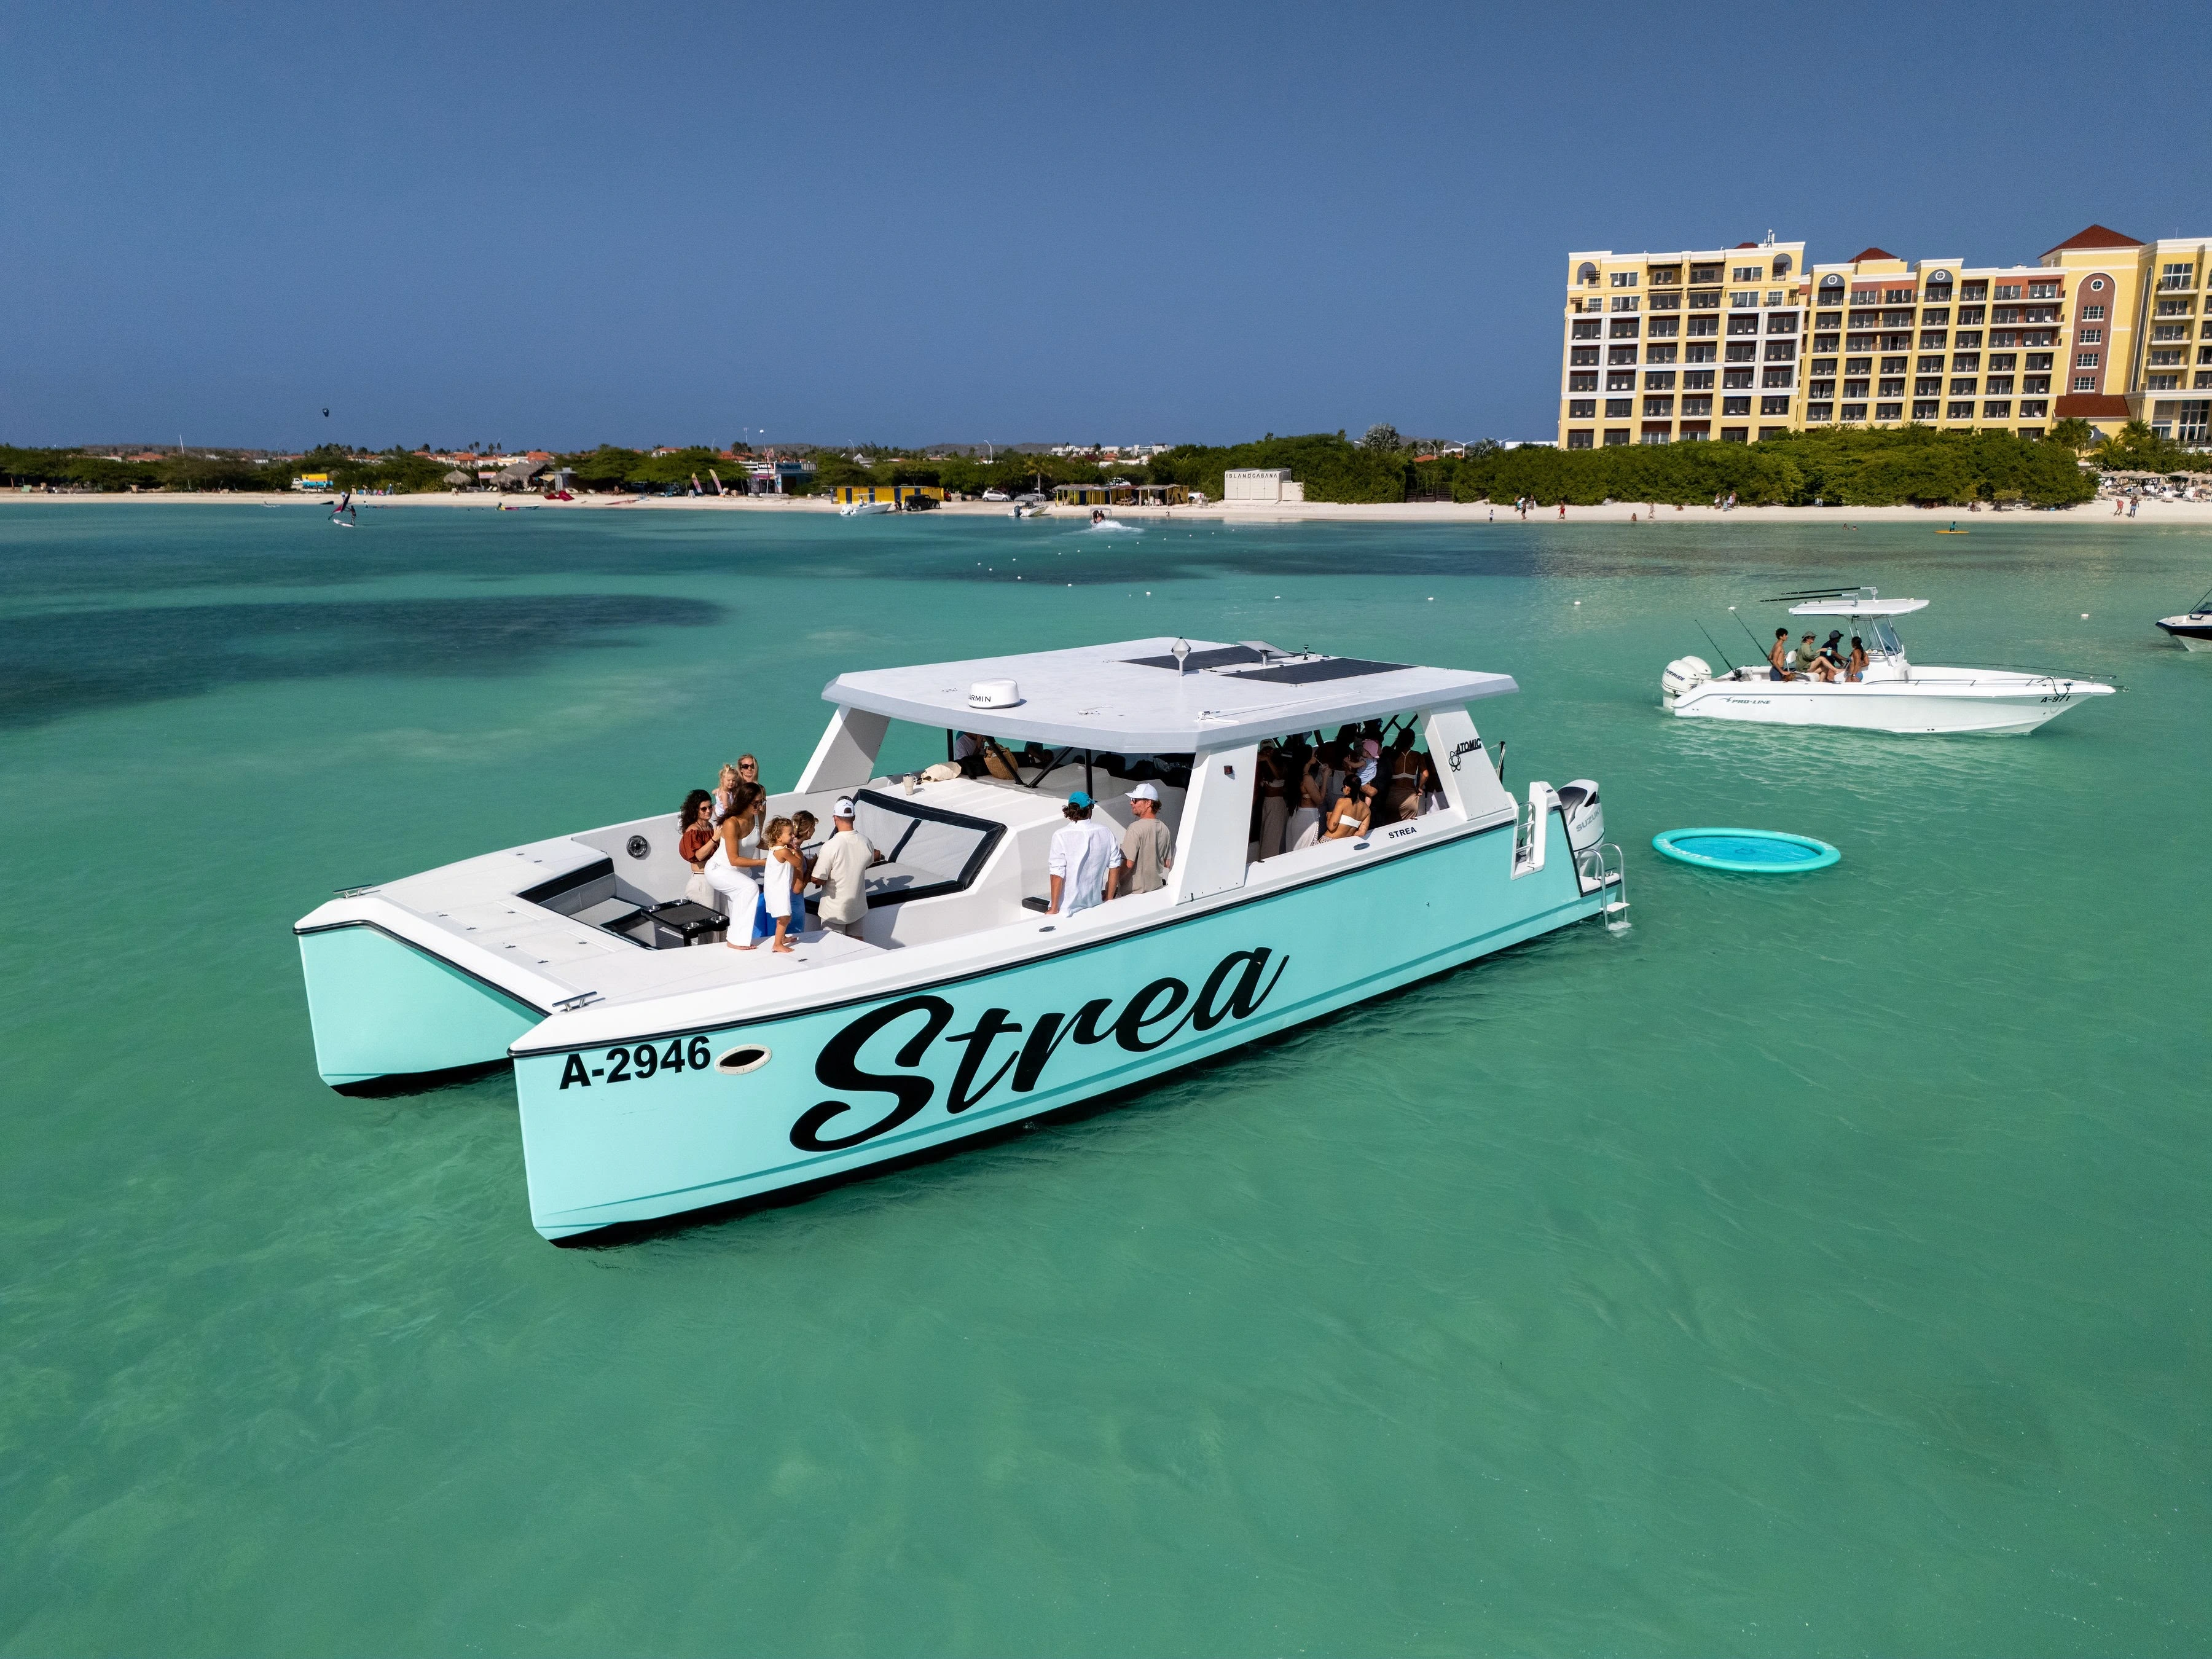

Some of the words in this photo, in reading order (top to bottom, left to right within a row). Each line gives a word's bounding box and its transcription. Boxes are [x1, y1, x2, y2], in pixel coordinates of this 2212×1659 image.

[1665, 668, 1685, 681] EVINRUDE
[1456, 737, 1482, 755] ATOMIC
[1575, 806, 1601, 832] SUZUKI
[1388, 826, 1417, 839] STREA
[789, 946, 1290, 1152] Strea
[559, 1035, 712, 1090] A-2946
